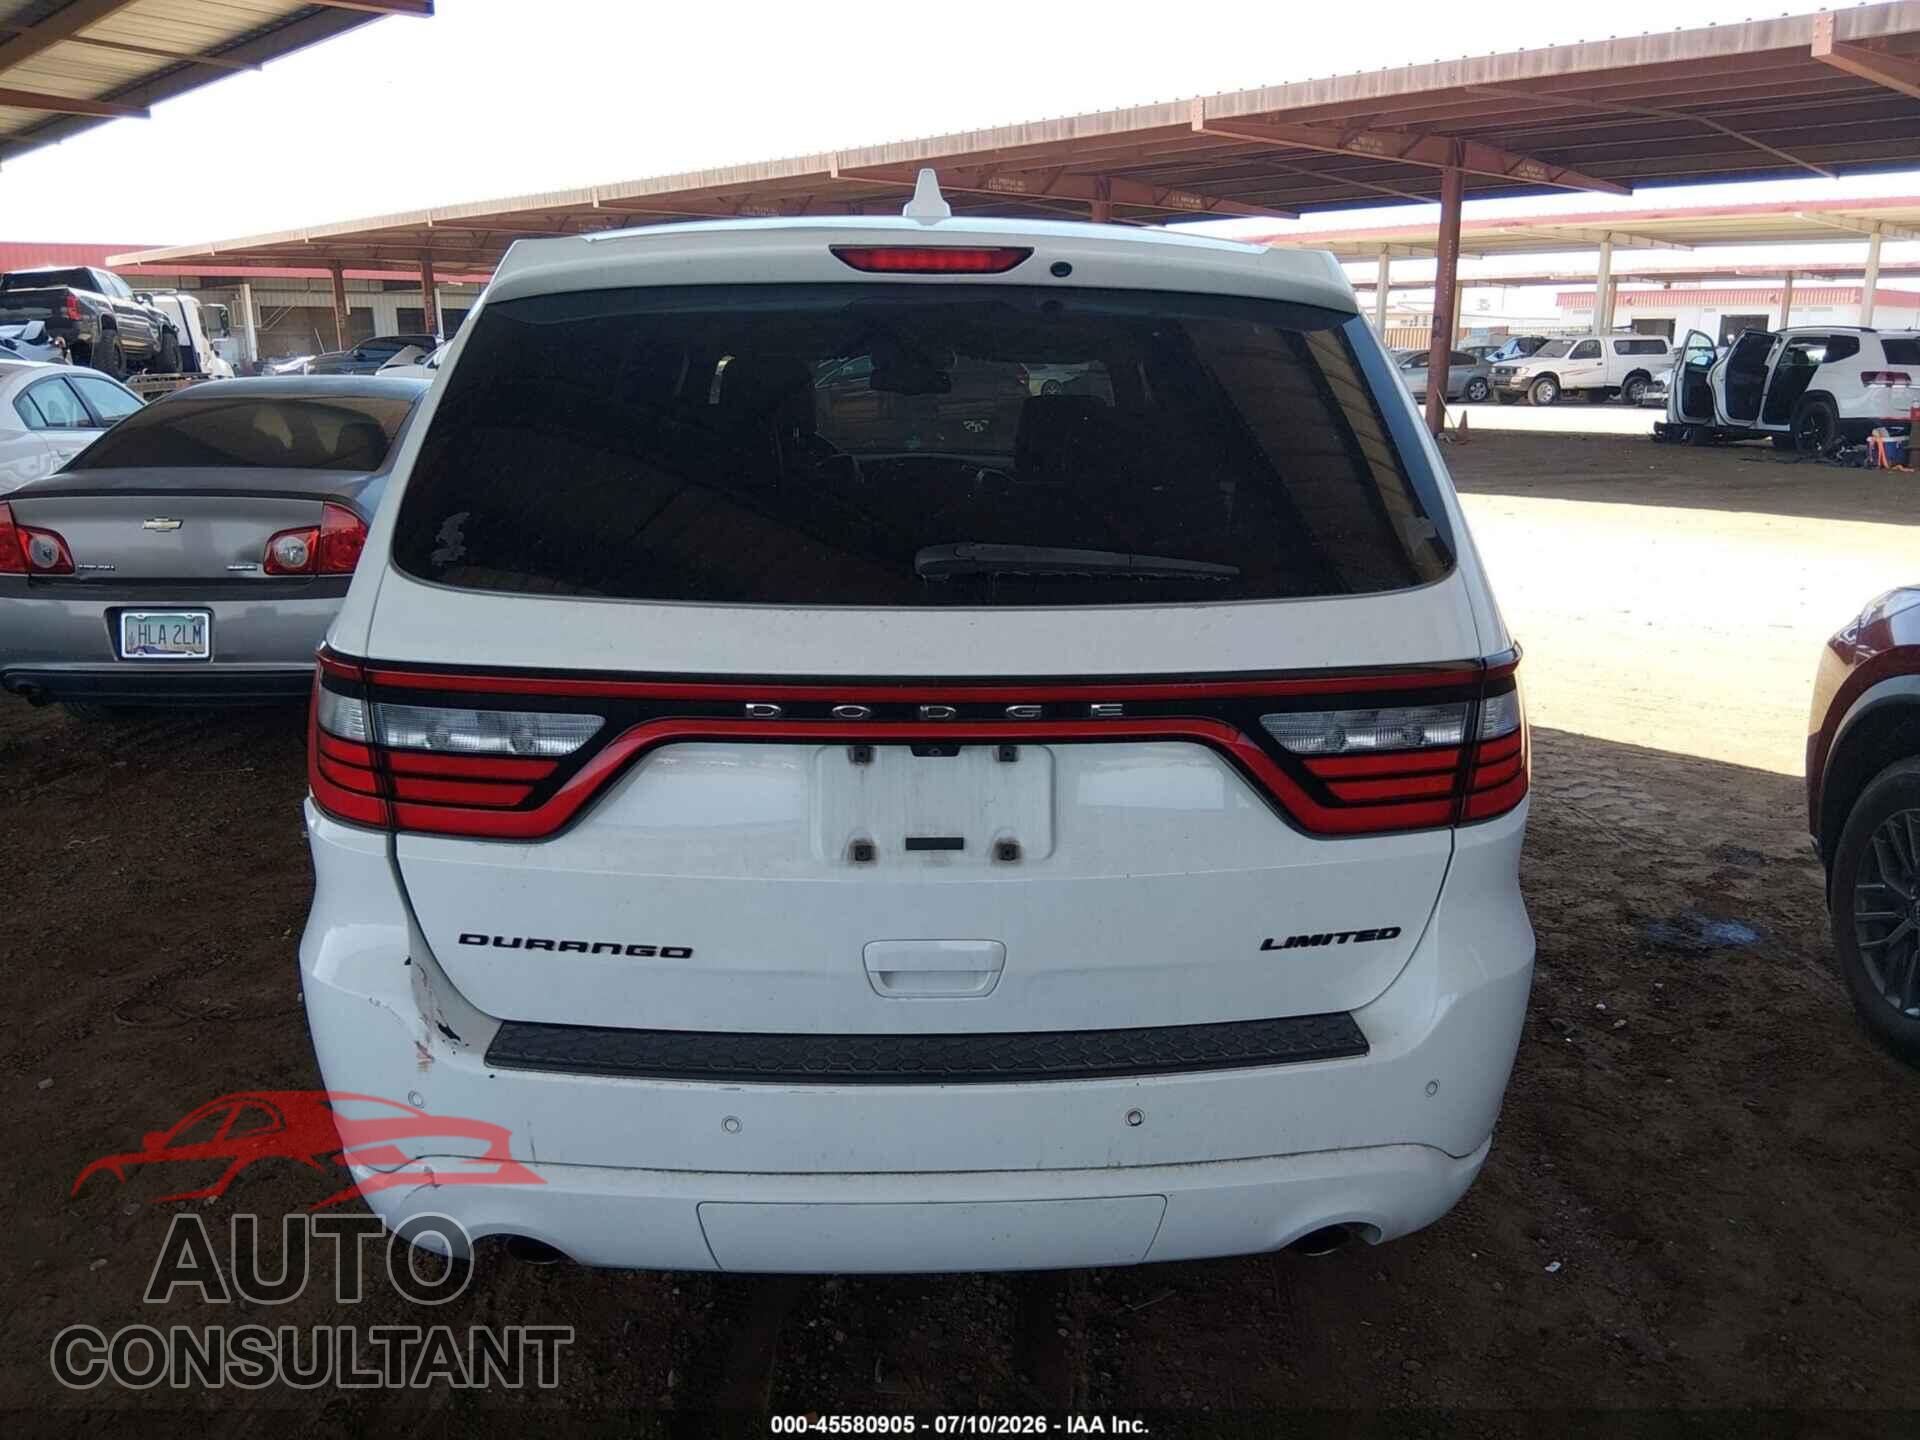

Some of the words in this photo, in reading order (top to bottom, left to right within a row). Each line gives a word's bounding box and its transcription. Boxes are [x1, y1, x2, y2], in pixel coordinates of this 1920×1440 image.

[137, 624, 167, 645] HLA
[745, 702, 1124, 719] DODGE
[458, 933, 693, 959] DURANGO
[1260, 926, 1402, 951] LIMITED
